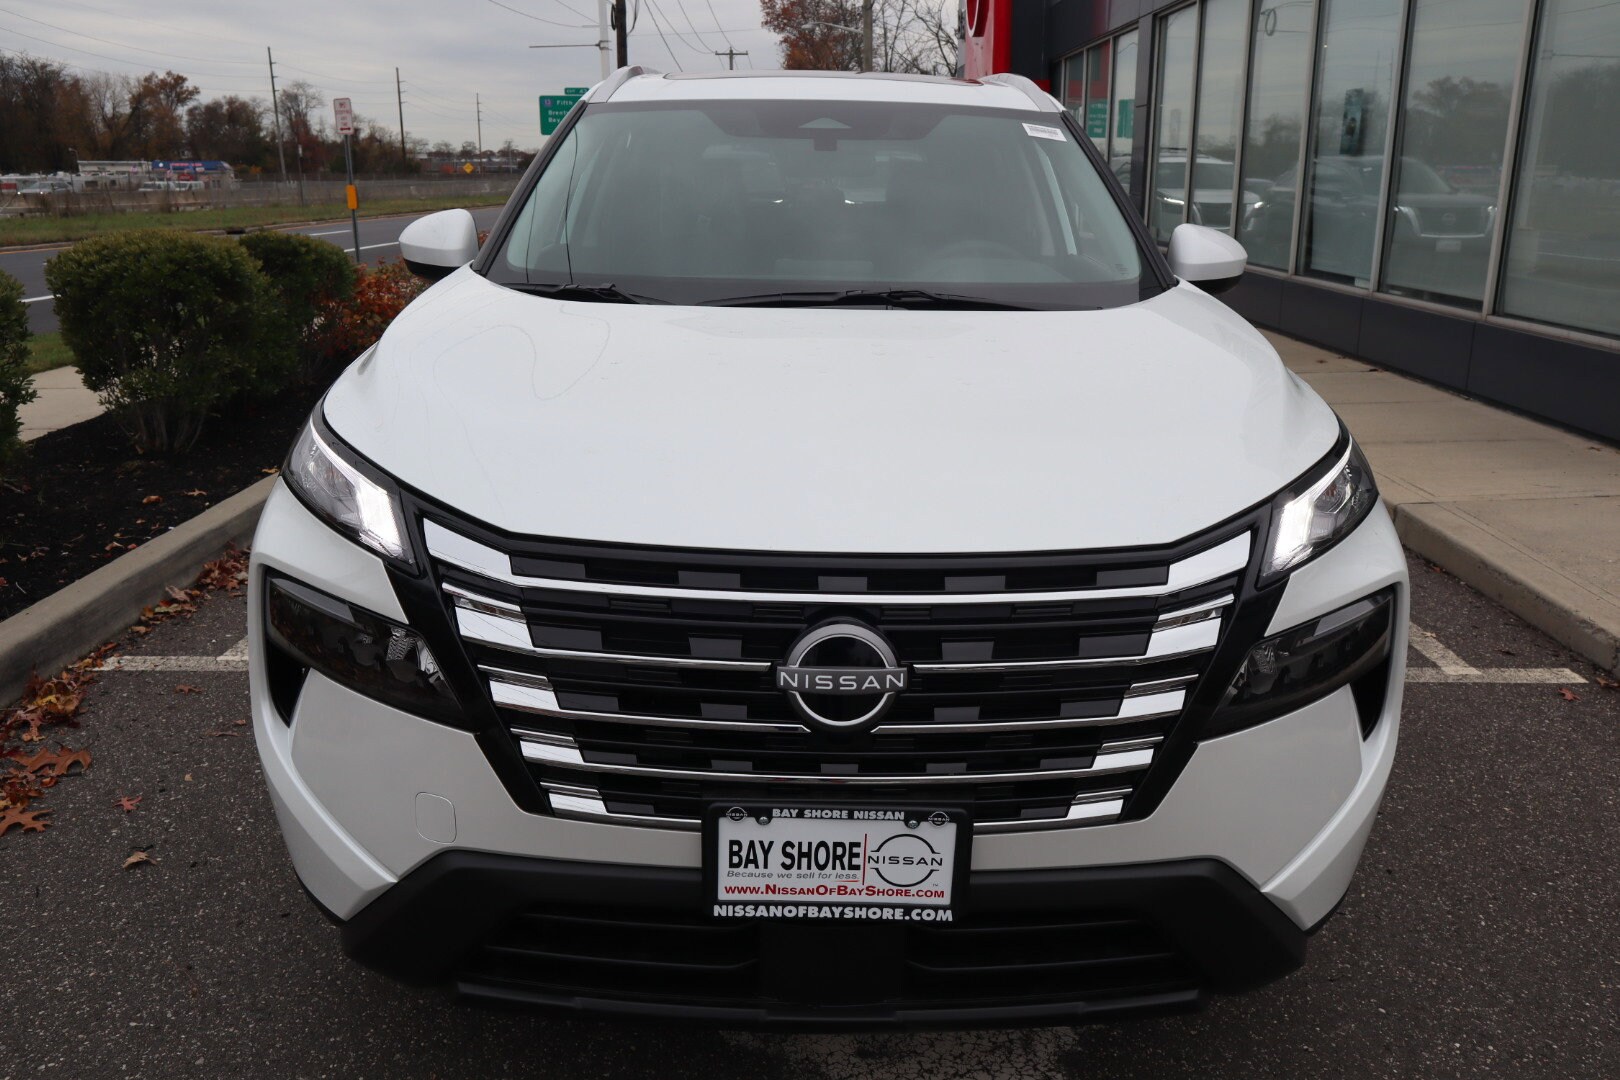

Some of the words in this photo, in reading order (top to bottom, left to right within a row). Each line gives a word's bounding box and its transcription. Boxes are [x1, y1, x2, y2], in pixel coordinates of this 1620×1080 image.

[780, 671, 904, 690] NISSAN
[772, 808, 799, 818] BAY
[803, 809, 848, 819] SHORE
[853, 810, 905, 820] NISSAN
[728, 839, 775, 869] BAY
[780, 840, 862, 871] SHORE
[868, 855, 943, 866] NISSAN
[727, 870, 773, 879] Because
[713, 904, 953, 921] NISSANOFBAYSHORE.COM
